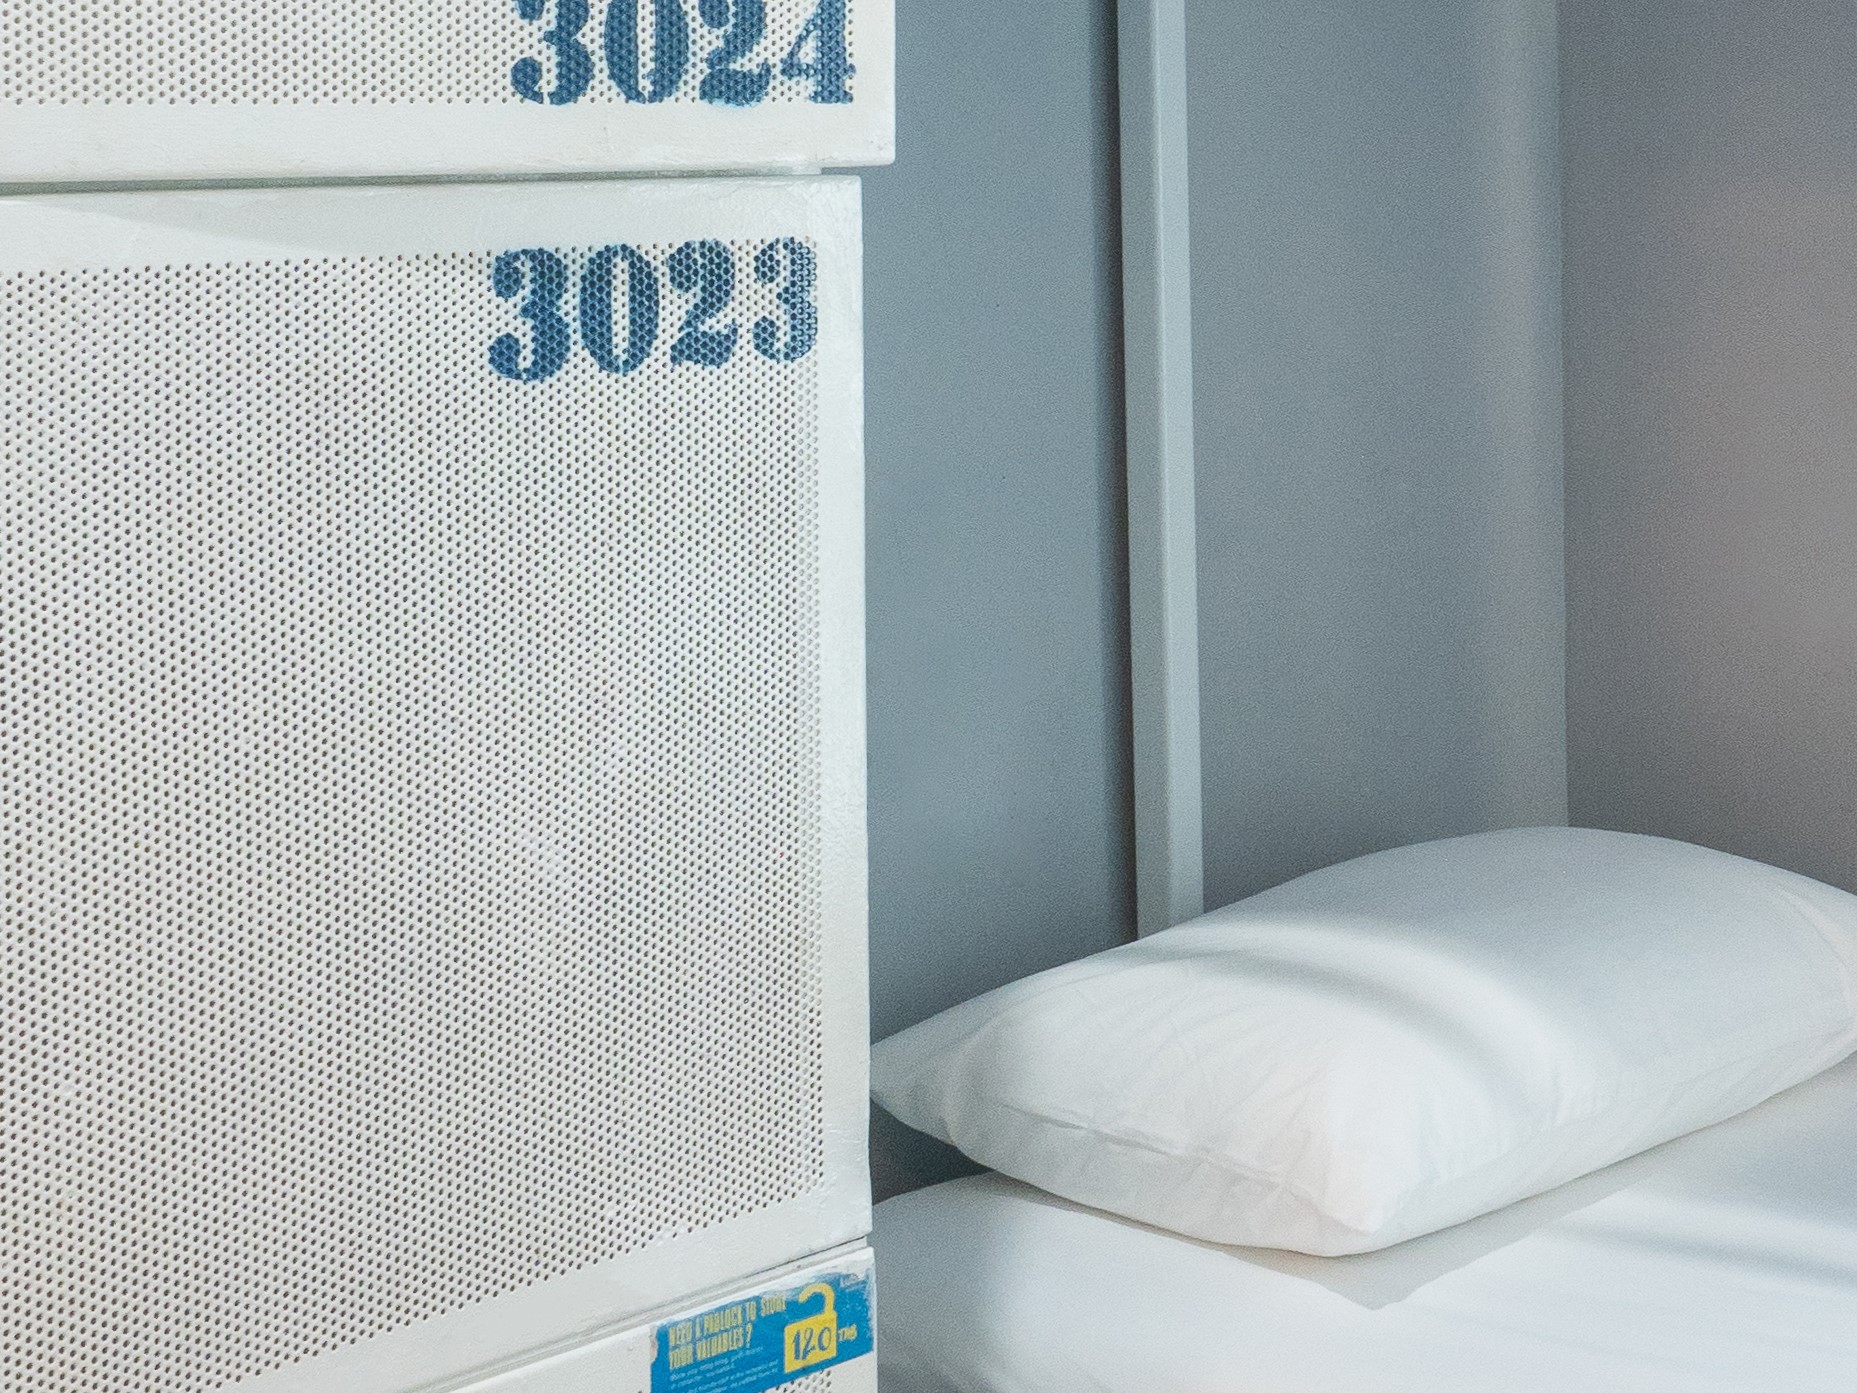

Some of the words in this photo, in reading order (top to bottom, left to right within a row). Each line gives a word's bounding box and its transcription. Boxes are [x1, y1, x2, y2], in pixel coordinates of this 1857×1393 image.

[488, 236, 819, 382] 3023
[669, 1321, 693, 1346] NEED
[695, 1317, 701, 1338] A
[704, 1304, 743, 1333] PADLOCK
[746, 1300, 756, 1321] TO
[760, 1294, 787, 1316] STORE
[793, 1326, 832, 1360] 120
[669, 1345, 693, 1370] YOUR
[696, 1327, 744, 1361] VALUABLES
[746, 1322, 753, 1348] ?
